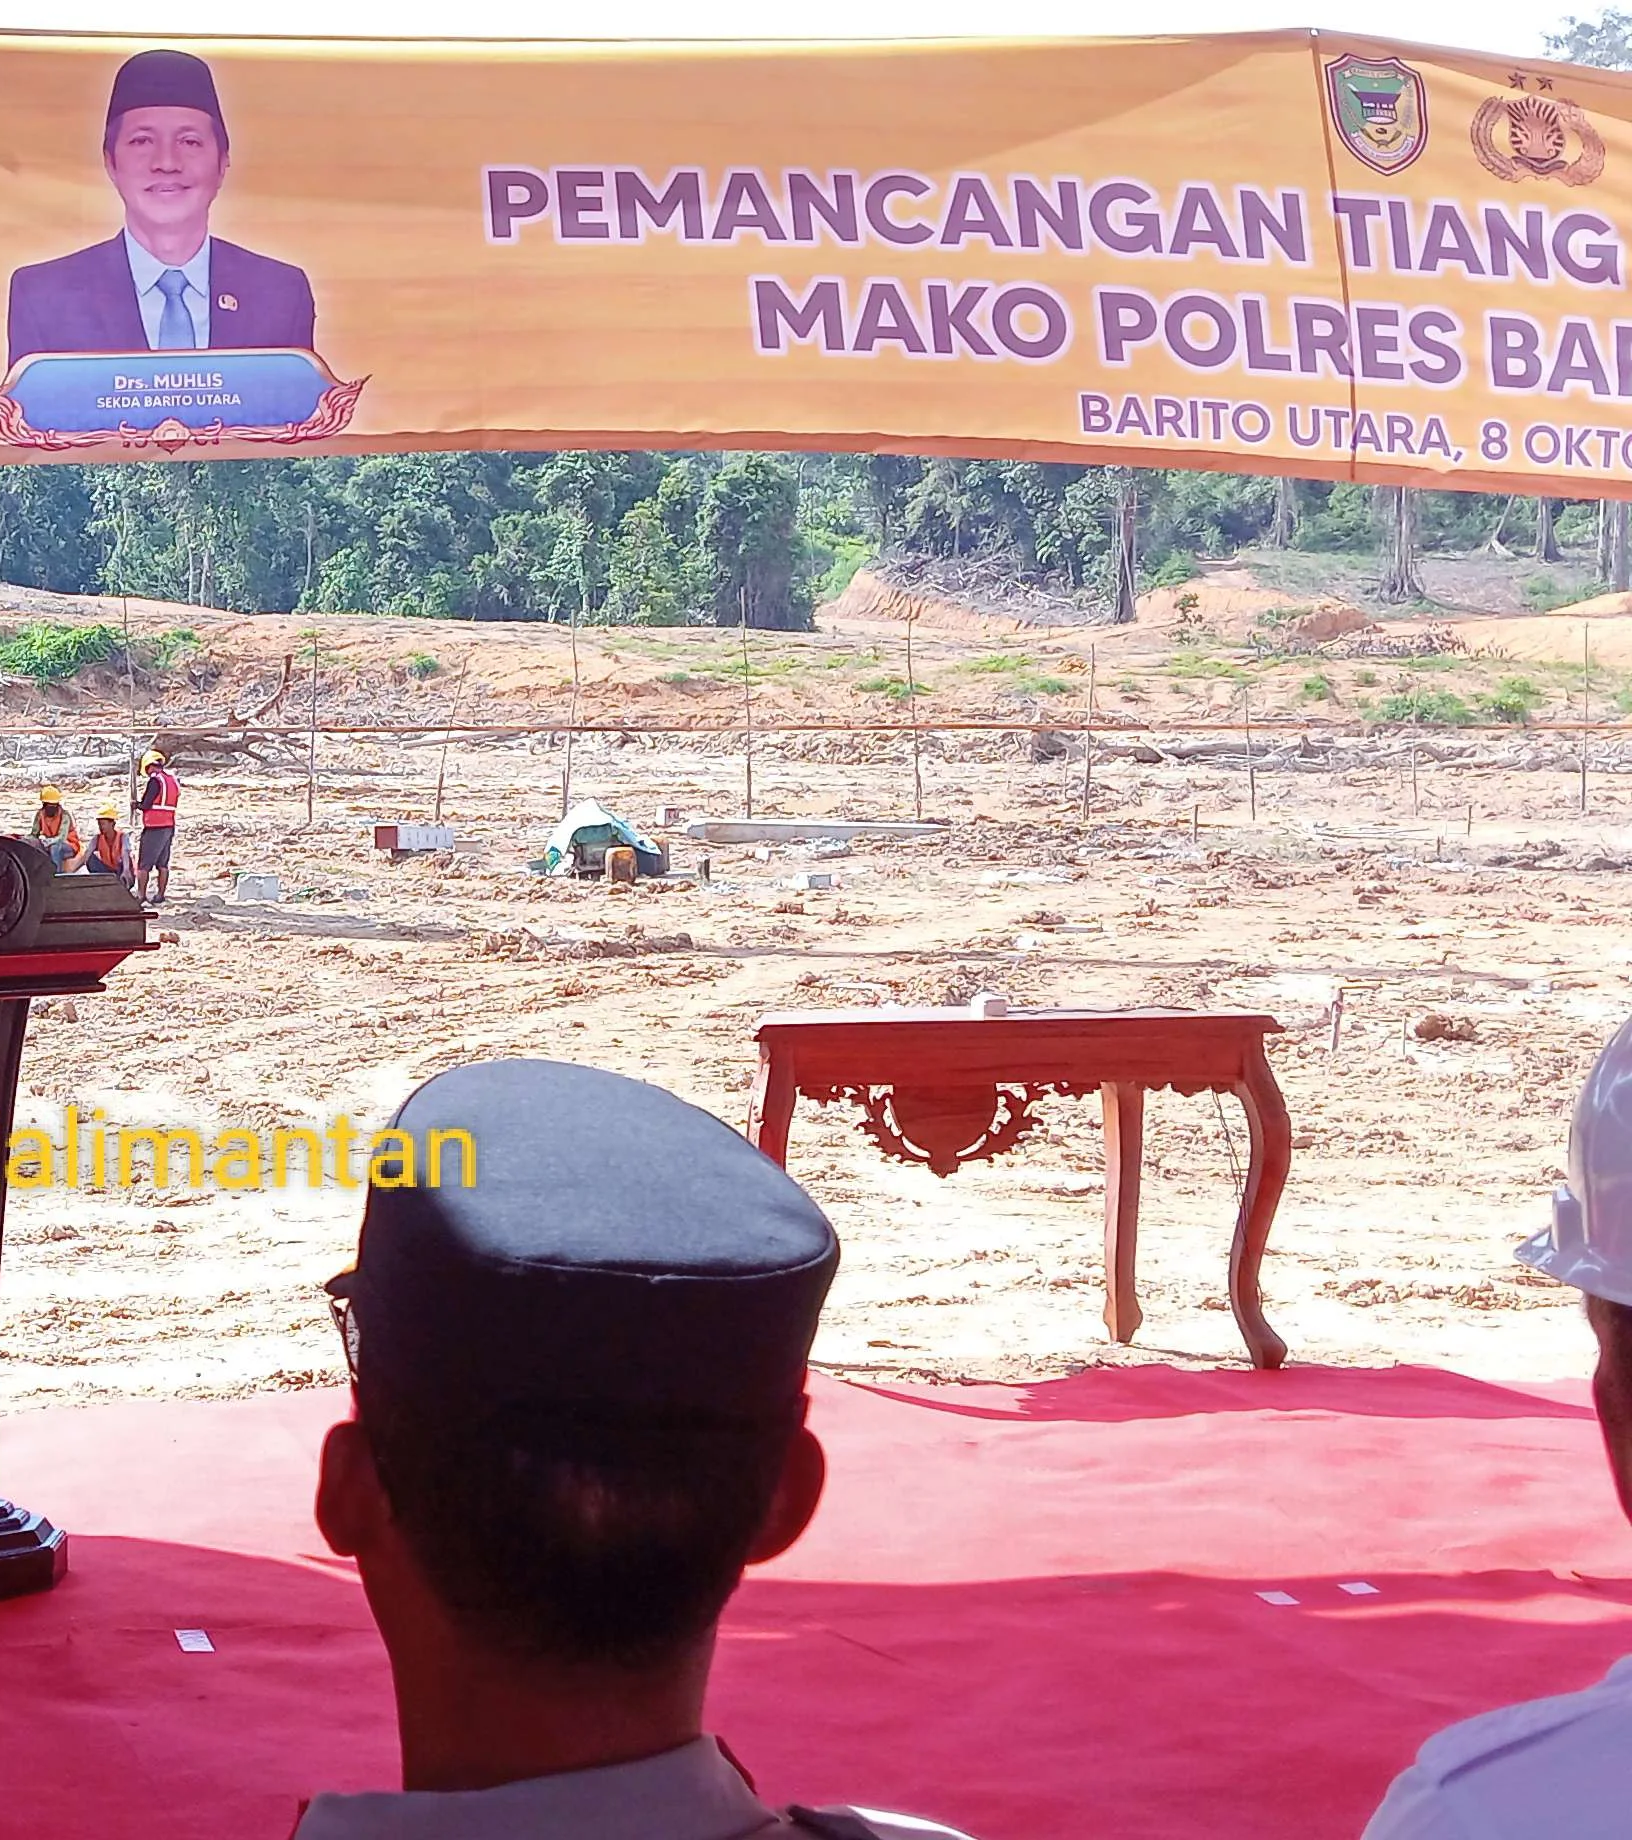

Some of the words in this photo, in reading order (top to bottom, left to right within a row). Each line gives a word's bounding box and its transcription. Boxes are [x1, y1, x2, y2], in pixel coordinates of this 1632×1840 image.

[487, 170, 1306, 262] PEMANCANGAN
[1333, 196, 1620, 285] TIANG
[754, 280, 1067, 359] MAKO
[1099, 291, 1462, 384] POLRES
[96, 395, 141, 409] SEKDA
[144, 394, 193, 408] BARITO
[196, 393, 241, 406] UTARA
[114, 375, 148, 390] Drs.
[153, 373, 224, 389] MUHLIS
[1080, 394, 1271, 442] BARITO
[1289, 408, 1463, 462] UTARA,
[1481, 421, 1508, 460] 8
